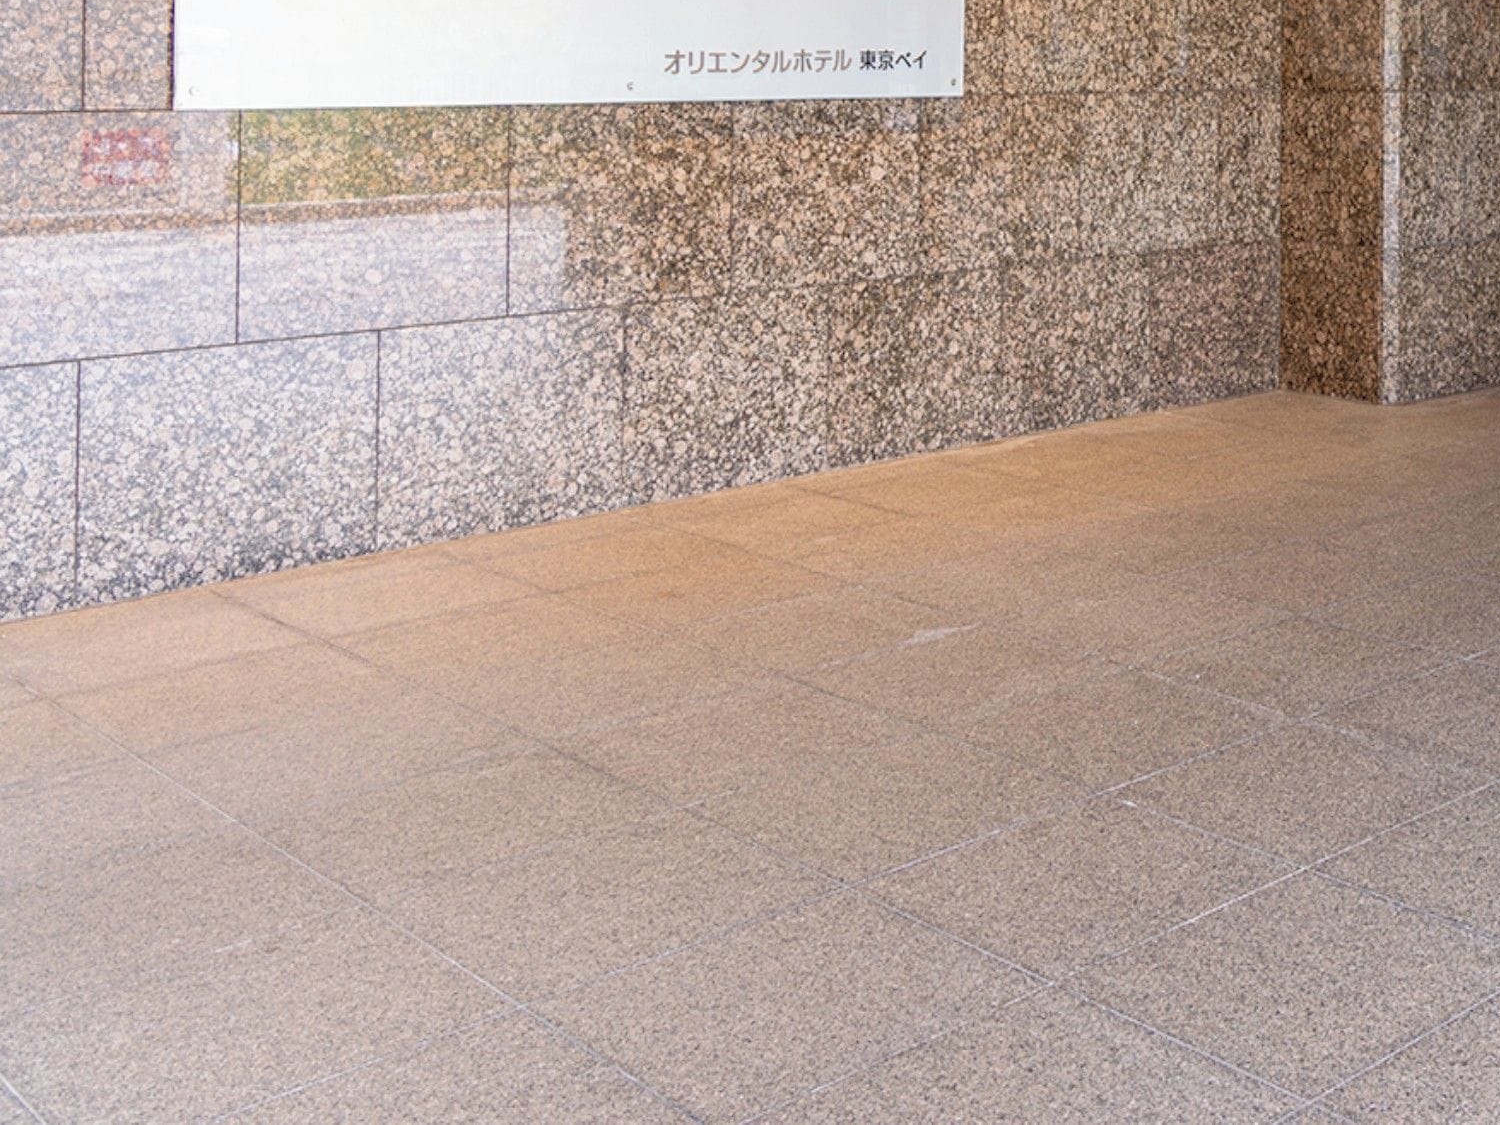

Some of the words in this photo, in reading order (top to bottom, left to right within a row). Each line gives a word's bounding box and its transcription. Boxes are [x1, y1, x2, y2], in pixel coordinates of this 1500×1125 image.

[664, 49, 852, 75] オリエンタルホテル
